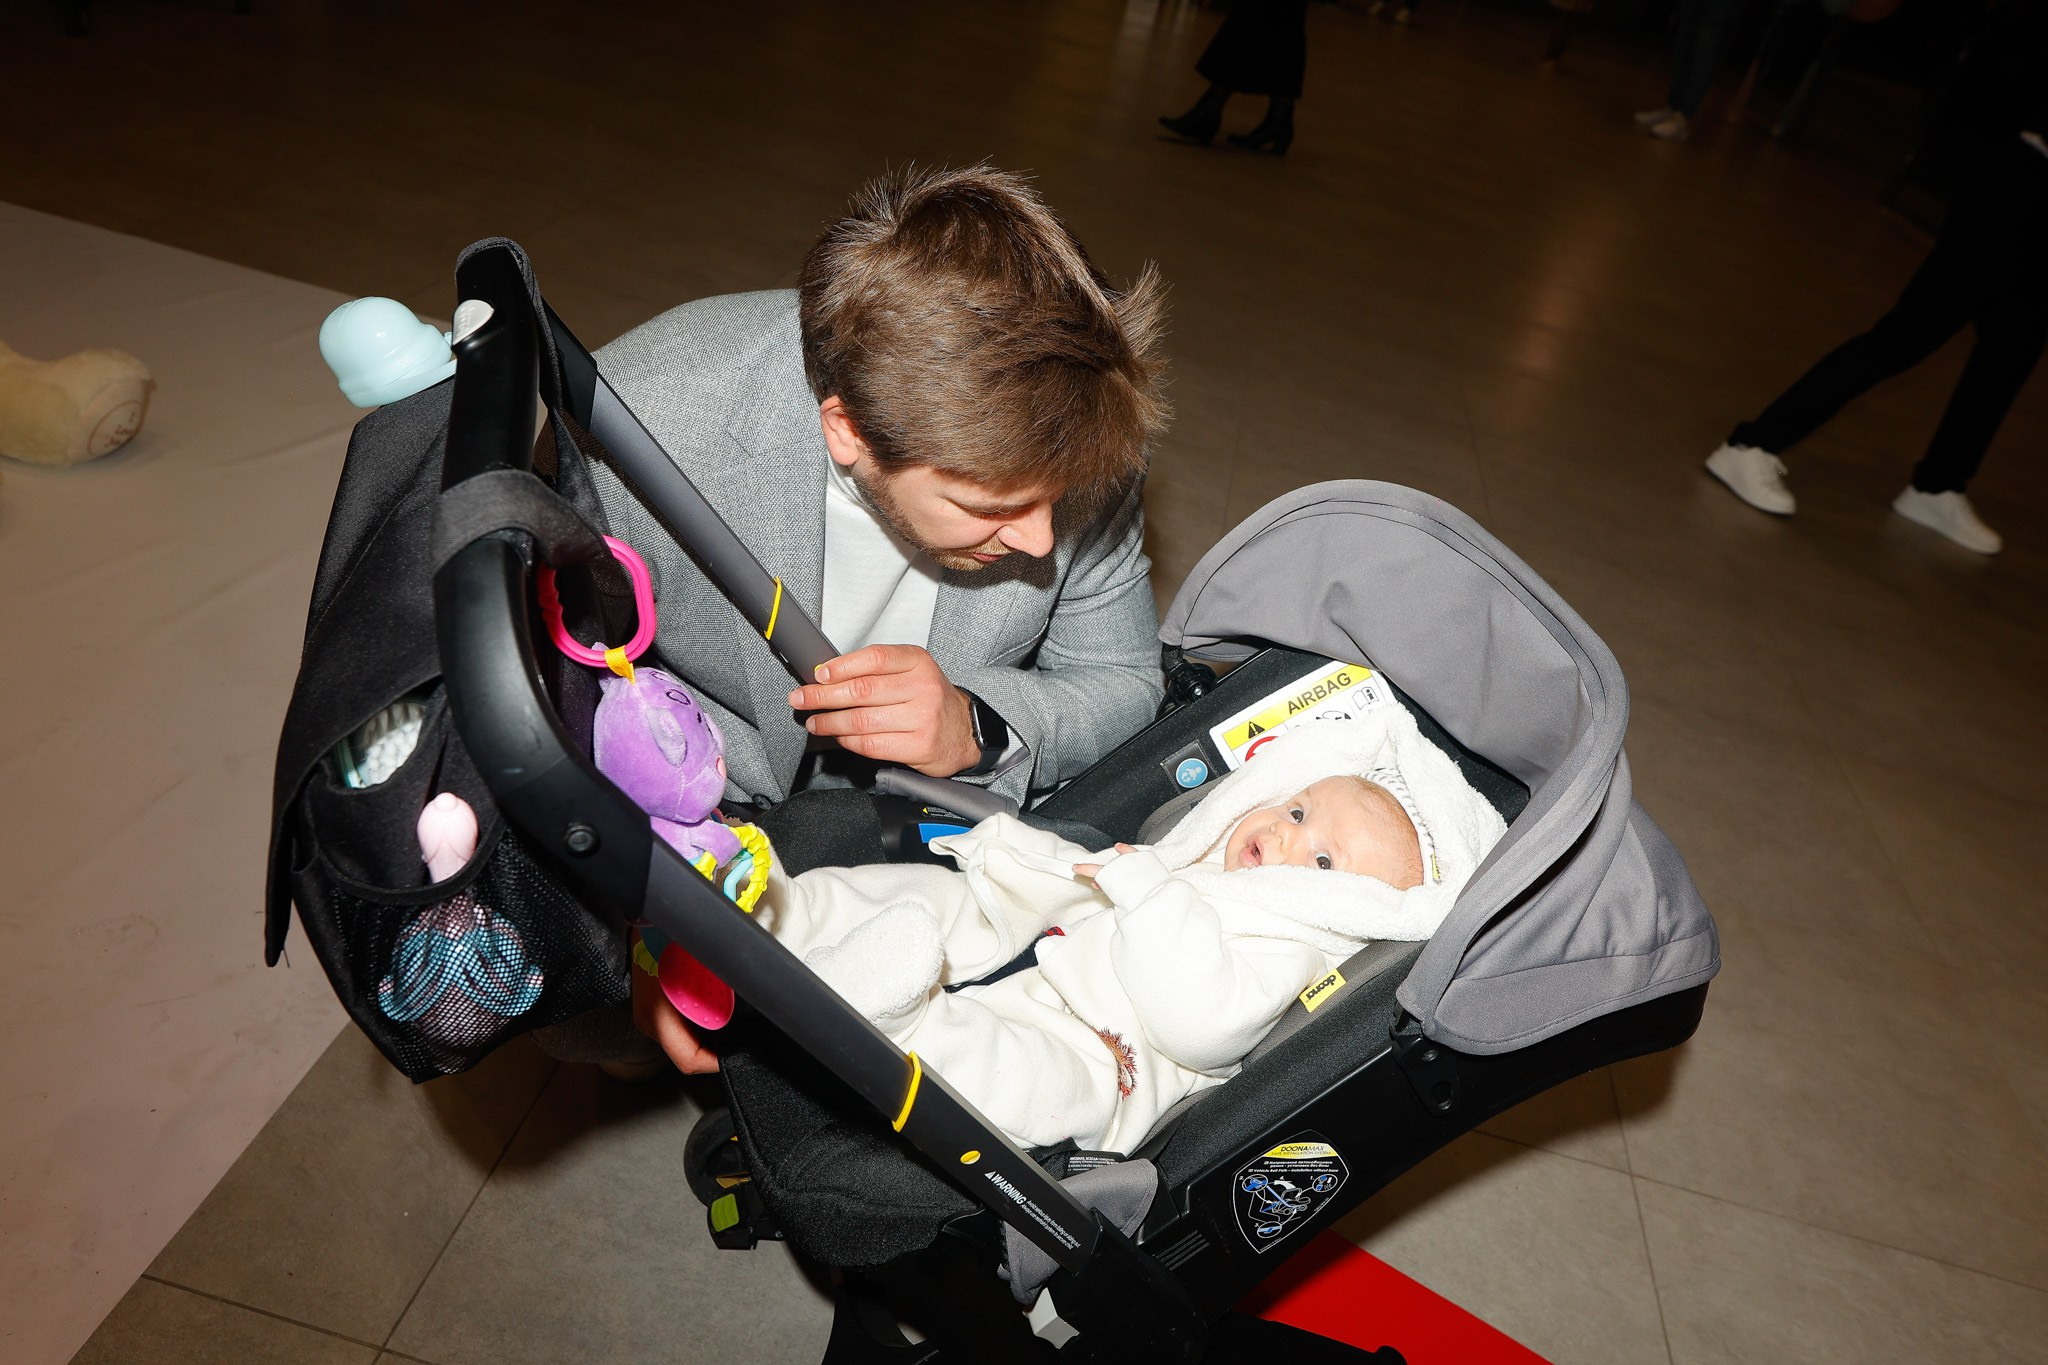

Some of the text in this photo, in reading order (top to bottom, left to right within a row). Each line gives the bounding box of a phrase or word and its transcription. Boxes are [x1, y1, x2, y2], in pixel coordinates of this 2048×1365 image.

[1288, 673, 1352, 714] AIRBAG
[1306, 974, 1336, 1000] doona
[991, 1174, 1026, 1204] WARNING
